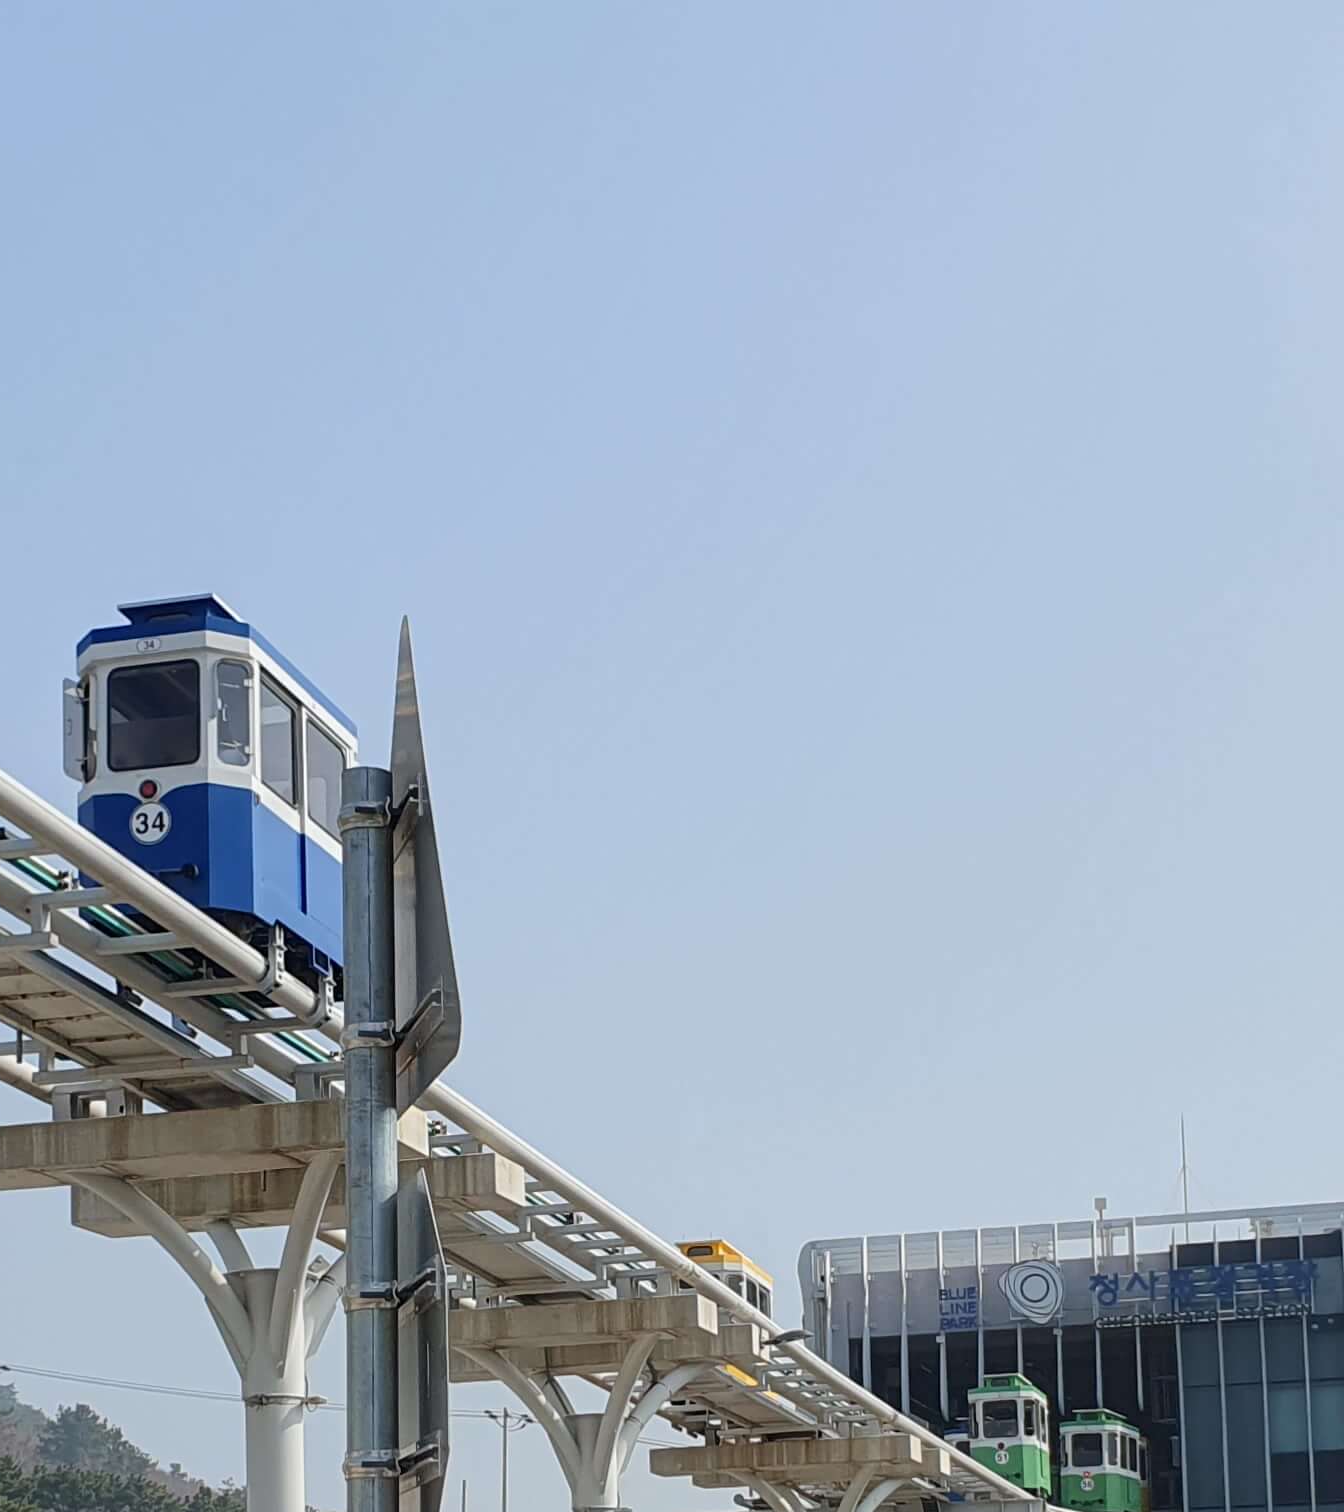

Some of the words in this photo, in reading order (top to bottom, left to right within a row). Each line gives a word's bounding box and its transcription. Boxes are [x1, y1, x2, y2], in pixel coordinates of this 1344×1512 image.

[143, 639, 155, 650] 34
[134, 811, 167, 834] 34
[939, 1286, 977, 1301] BLUE
[939, 1301, 977, 1315] LINE
[940, 1315, 977, 1331] PARK
[996, 1453, 1008, 1462] 51
